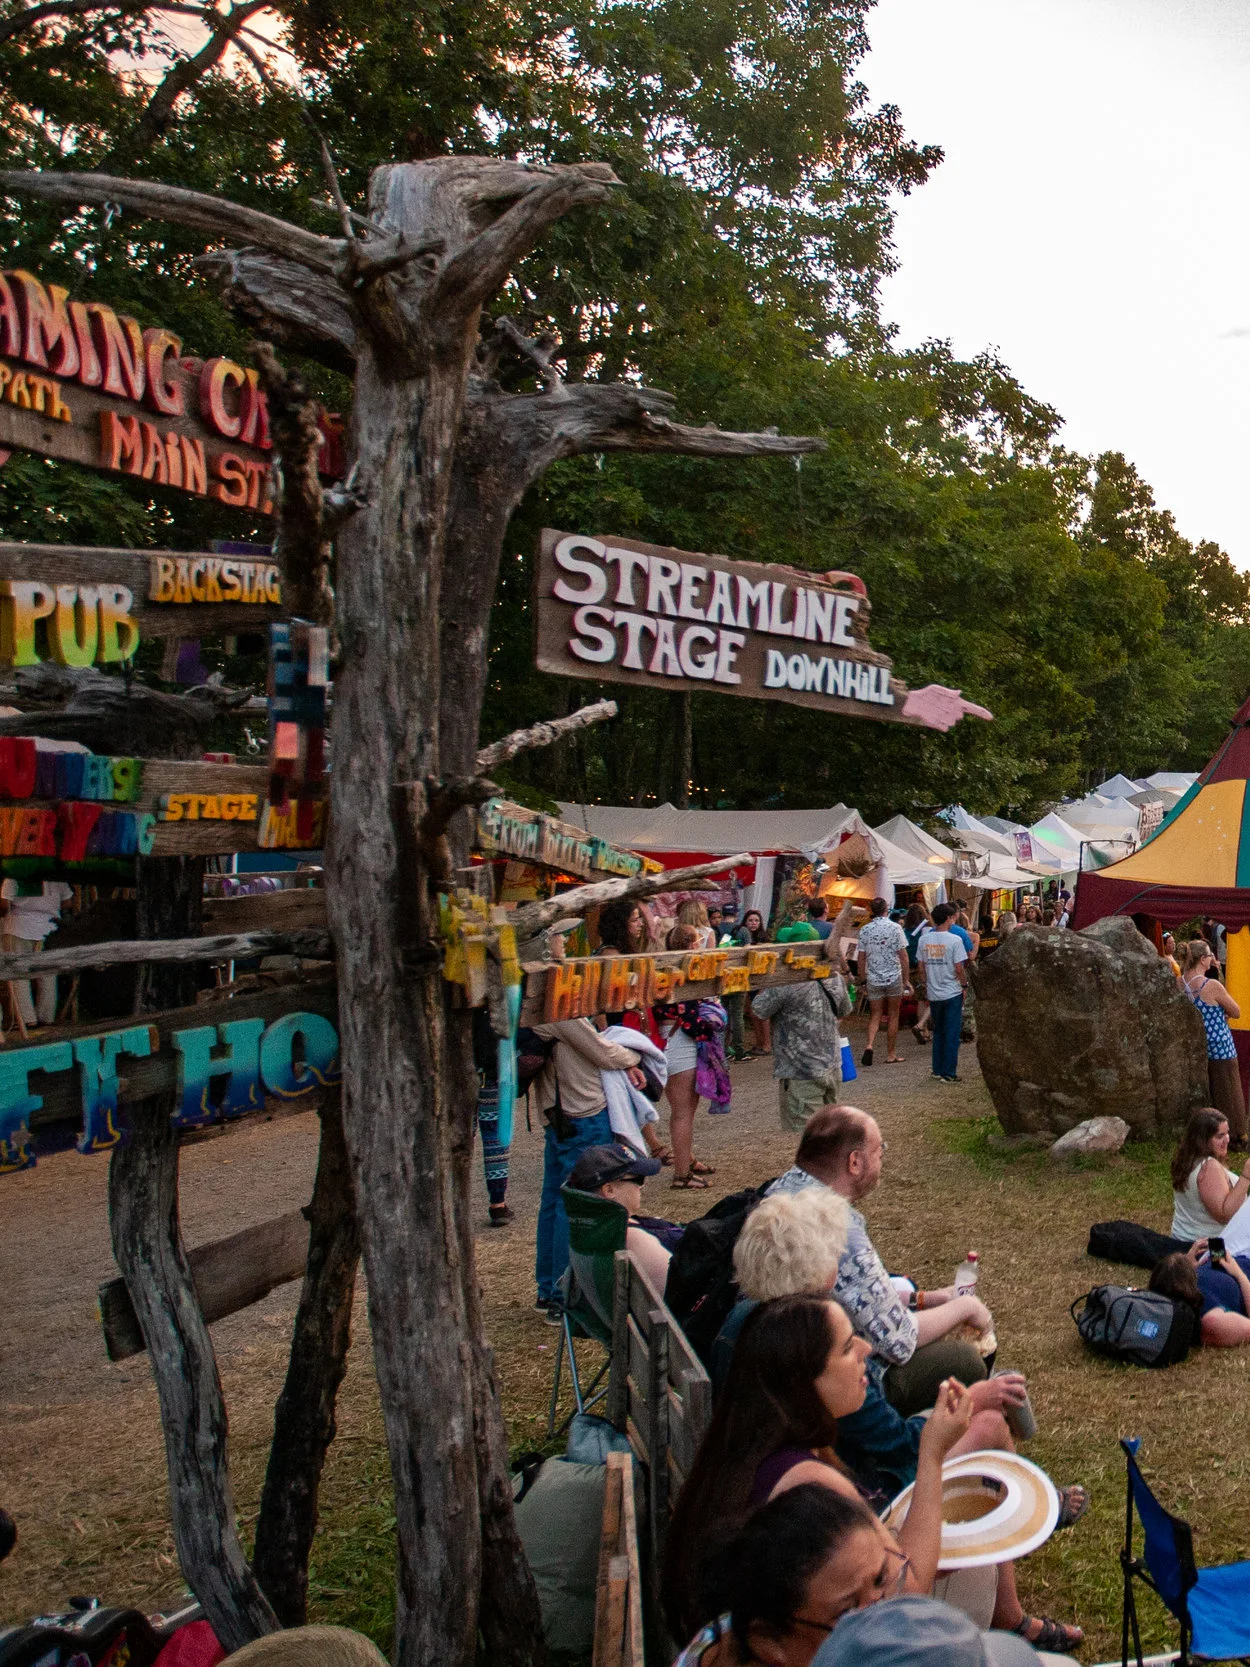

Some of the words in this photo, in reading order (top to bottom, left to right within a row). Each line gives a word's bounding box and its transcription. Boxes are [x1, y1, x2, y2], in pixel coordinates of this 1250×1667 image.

[8, 581, 140, 668] PUB
[553, 535, 860, 648] STREAMLINE
[568, 605, 746, 685] STAGE
[763, 648, 895, 706] DOWNHILL
[159, 793, 259, 822] STAGE
